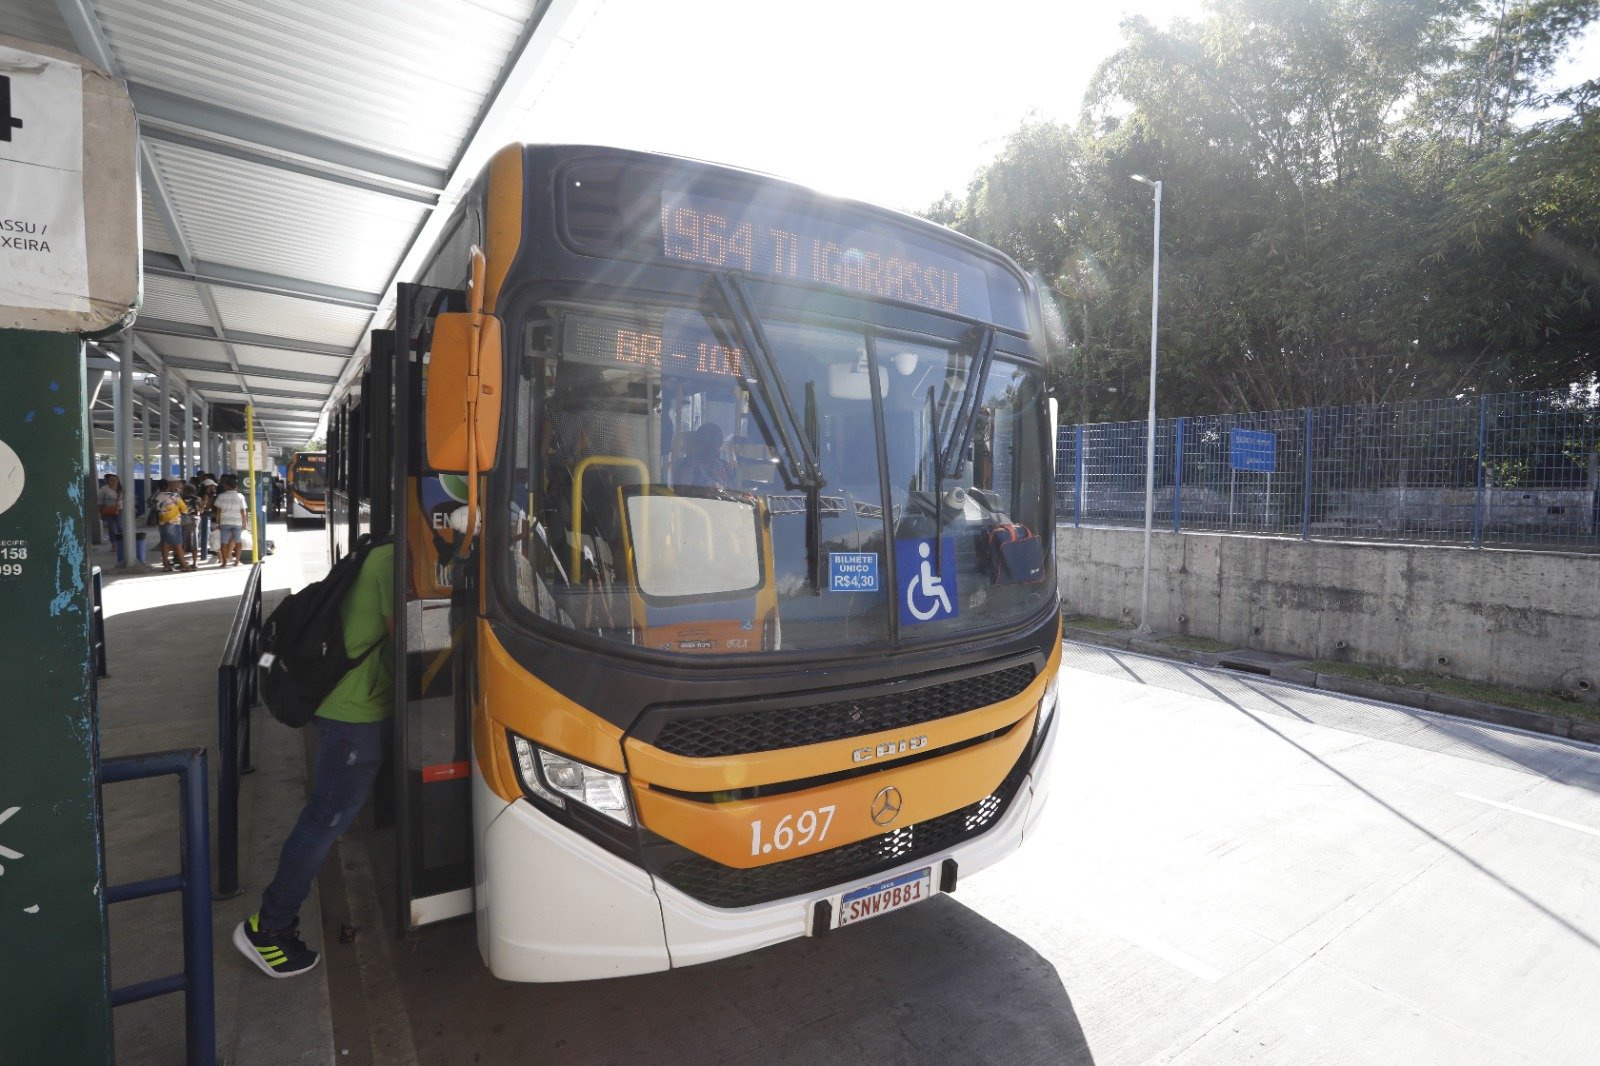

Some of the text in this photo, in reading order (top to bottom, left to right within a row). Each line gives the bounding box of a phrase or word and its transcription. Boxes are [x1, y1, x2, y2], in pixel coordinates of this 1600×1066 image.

[770, 227, 797, 278] TI
[812, 239, 959, 314] IGARASSU
[616, 329, 662, 367] BR
[696, 341, 744, 377] 101
[0, 563, 23, 576] 99
[834, 556, 873, 564] BILHETE
[840, 563, 869, 572] ÚNICO
[834, 575, 874, 588] R$4,30
[750, 804, 837, 857] 1.697
[849, 880, 922, 921] SNW9B81
